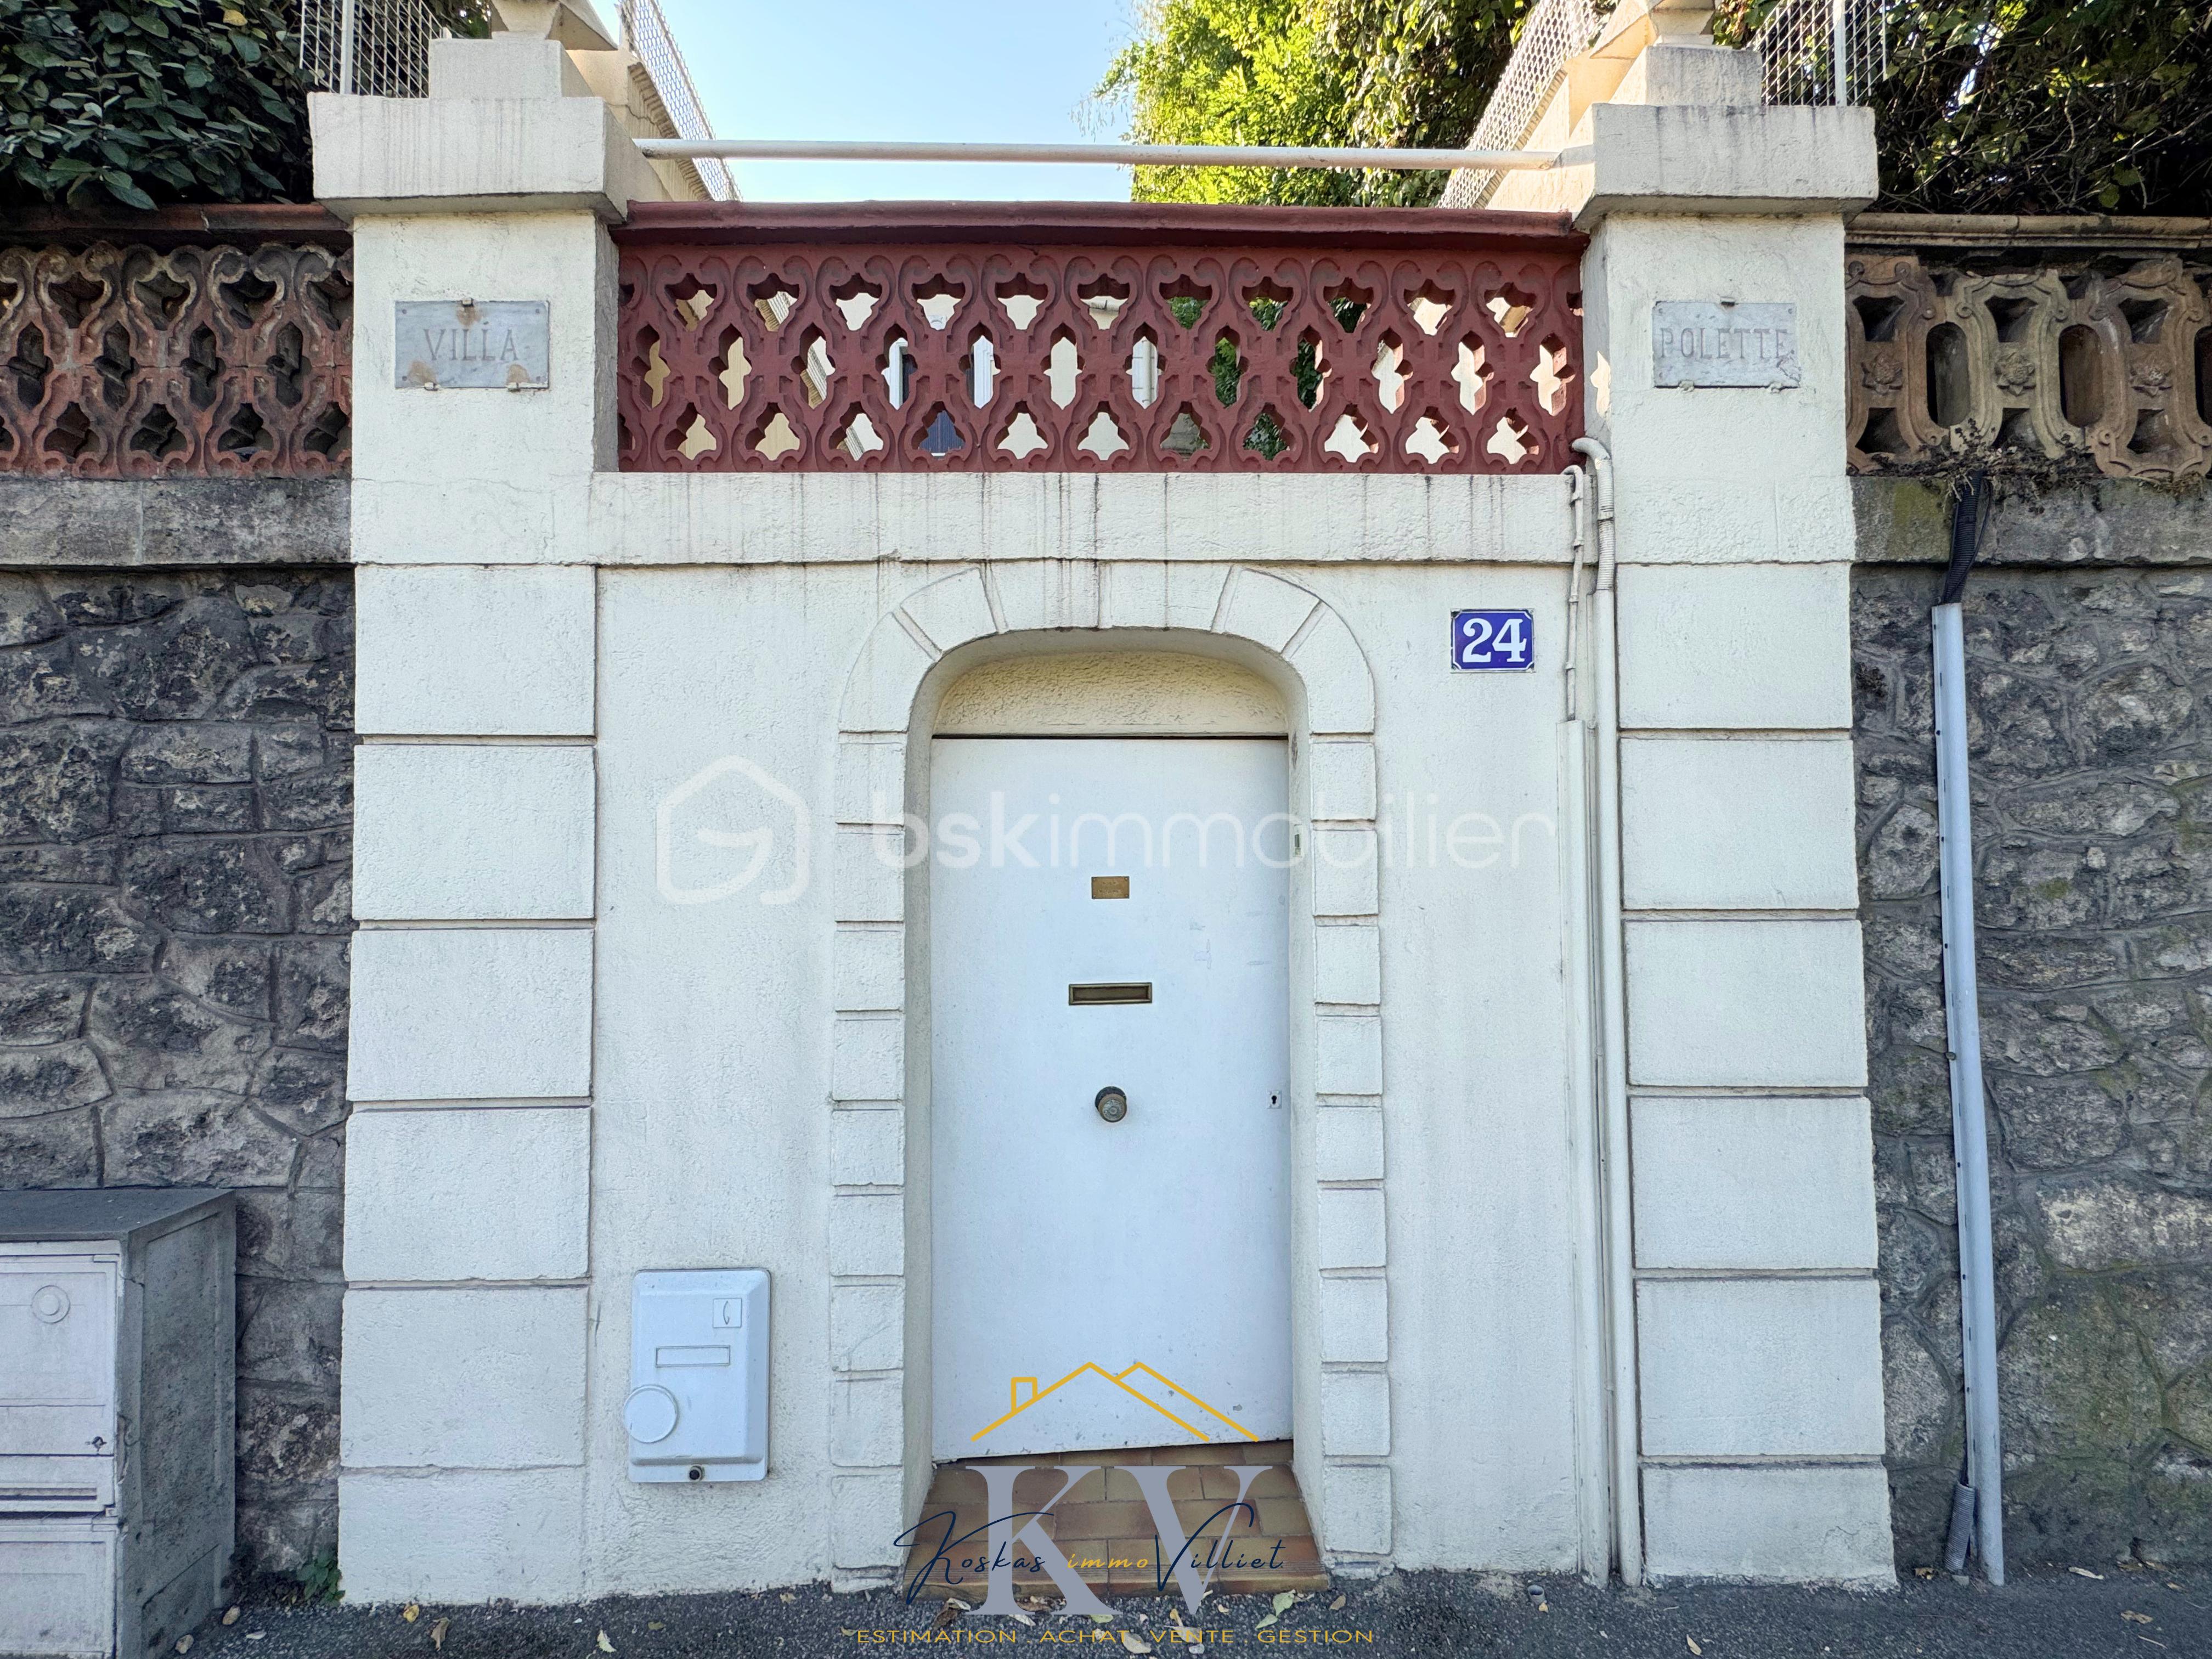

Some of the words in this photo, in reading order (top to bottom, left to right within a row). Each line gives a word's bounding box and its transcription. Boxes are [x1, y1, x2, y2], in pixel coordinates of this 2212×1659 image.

[424, 329, 518, 361] VILLA
[1660, 328, 1788, 358] POLETTE
[1463, 618, 1527, 663] 24
